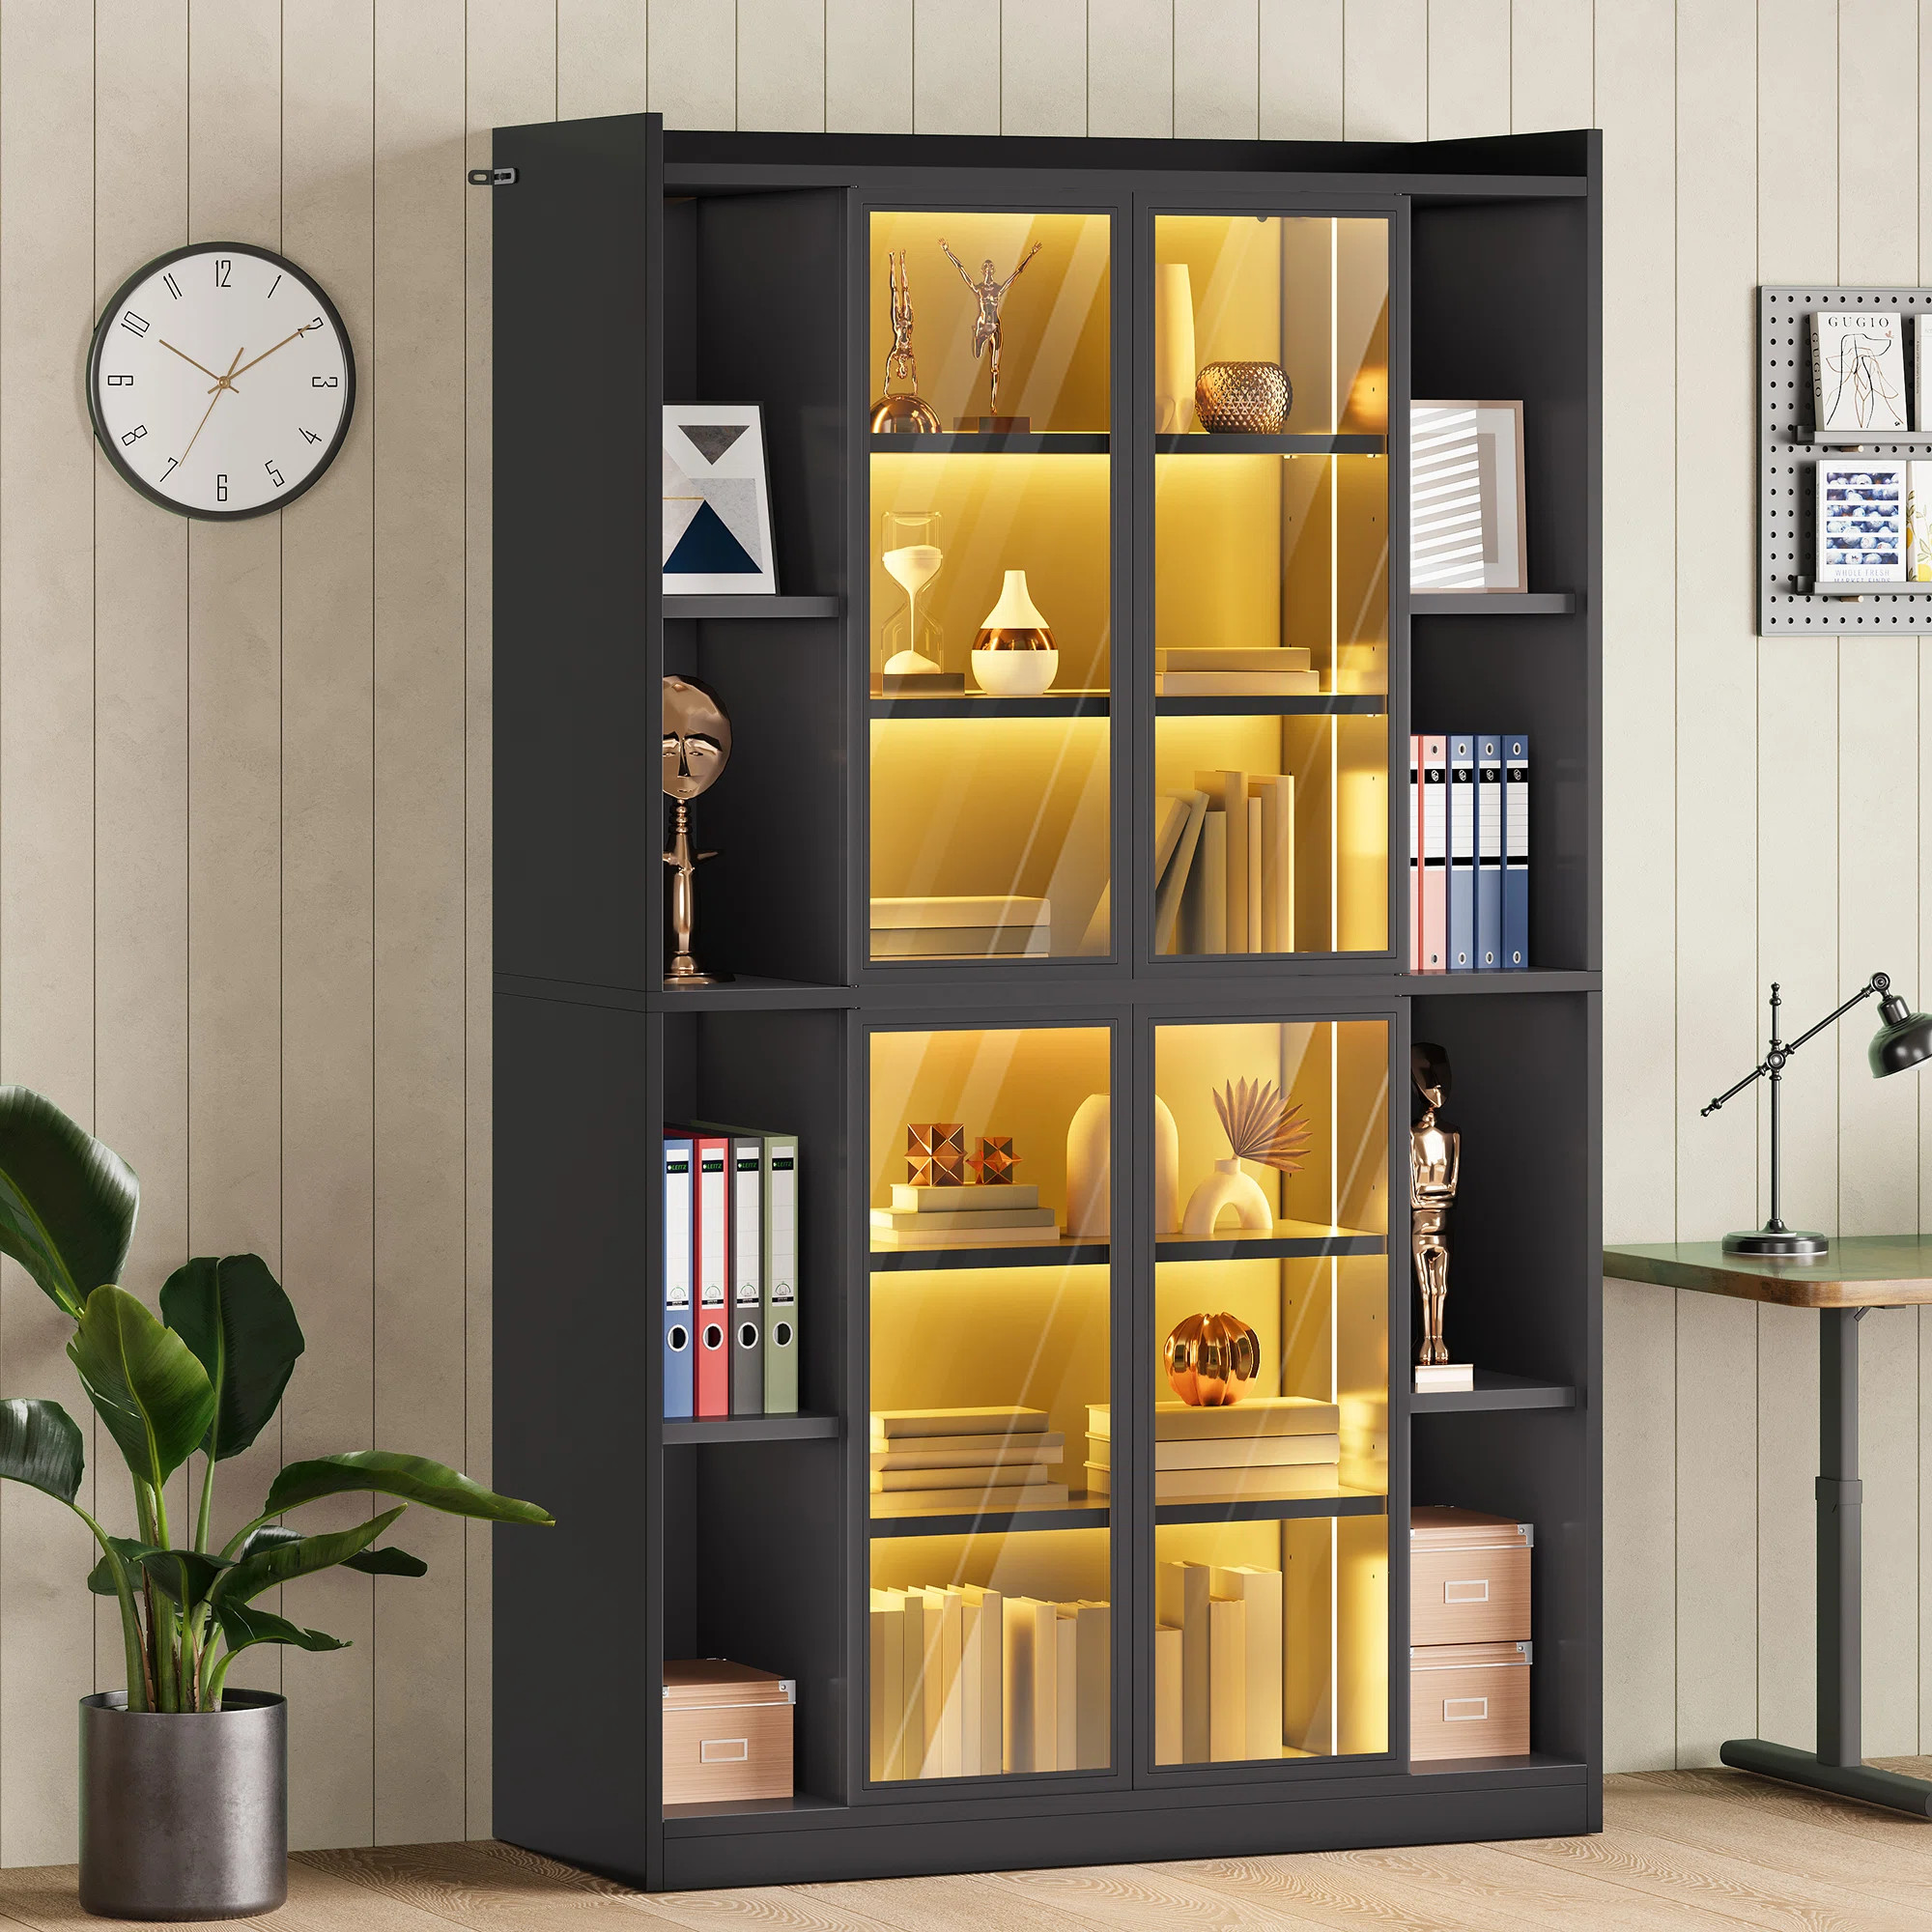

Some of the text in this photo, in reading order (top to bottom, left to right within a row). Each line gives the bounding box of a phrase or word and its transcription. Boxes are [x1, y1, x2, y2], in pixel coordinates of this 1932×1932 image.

[162, 272, 183, 299] 11
[214, 260, 231, 288] 12
[267, 274, 282, 298] 1
[121, 310, 150, 338] 10
[298, 317, 324, 338] 2
[1828, 317, 1889, 327] GUGIO
[1812, 332, 1822, 397] GUGIO
[107, 375, 134, 386] 9
[311, 376, 338, 387] 3
[121, 424, 148, 446] 8
[298, 427, 323, 444] 4
[159, 457, 179, 483] 7
[265, 459, 285, 488] 5
[216, 473, 228, 501] 6
